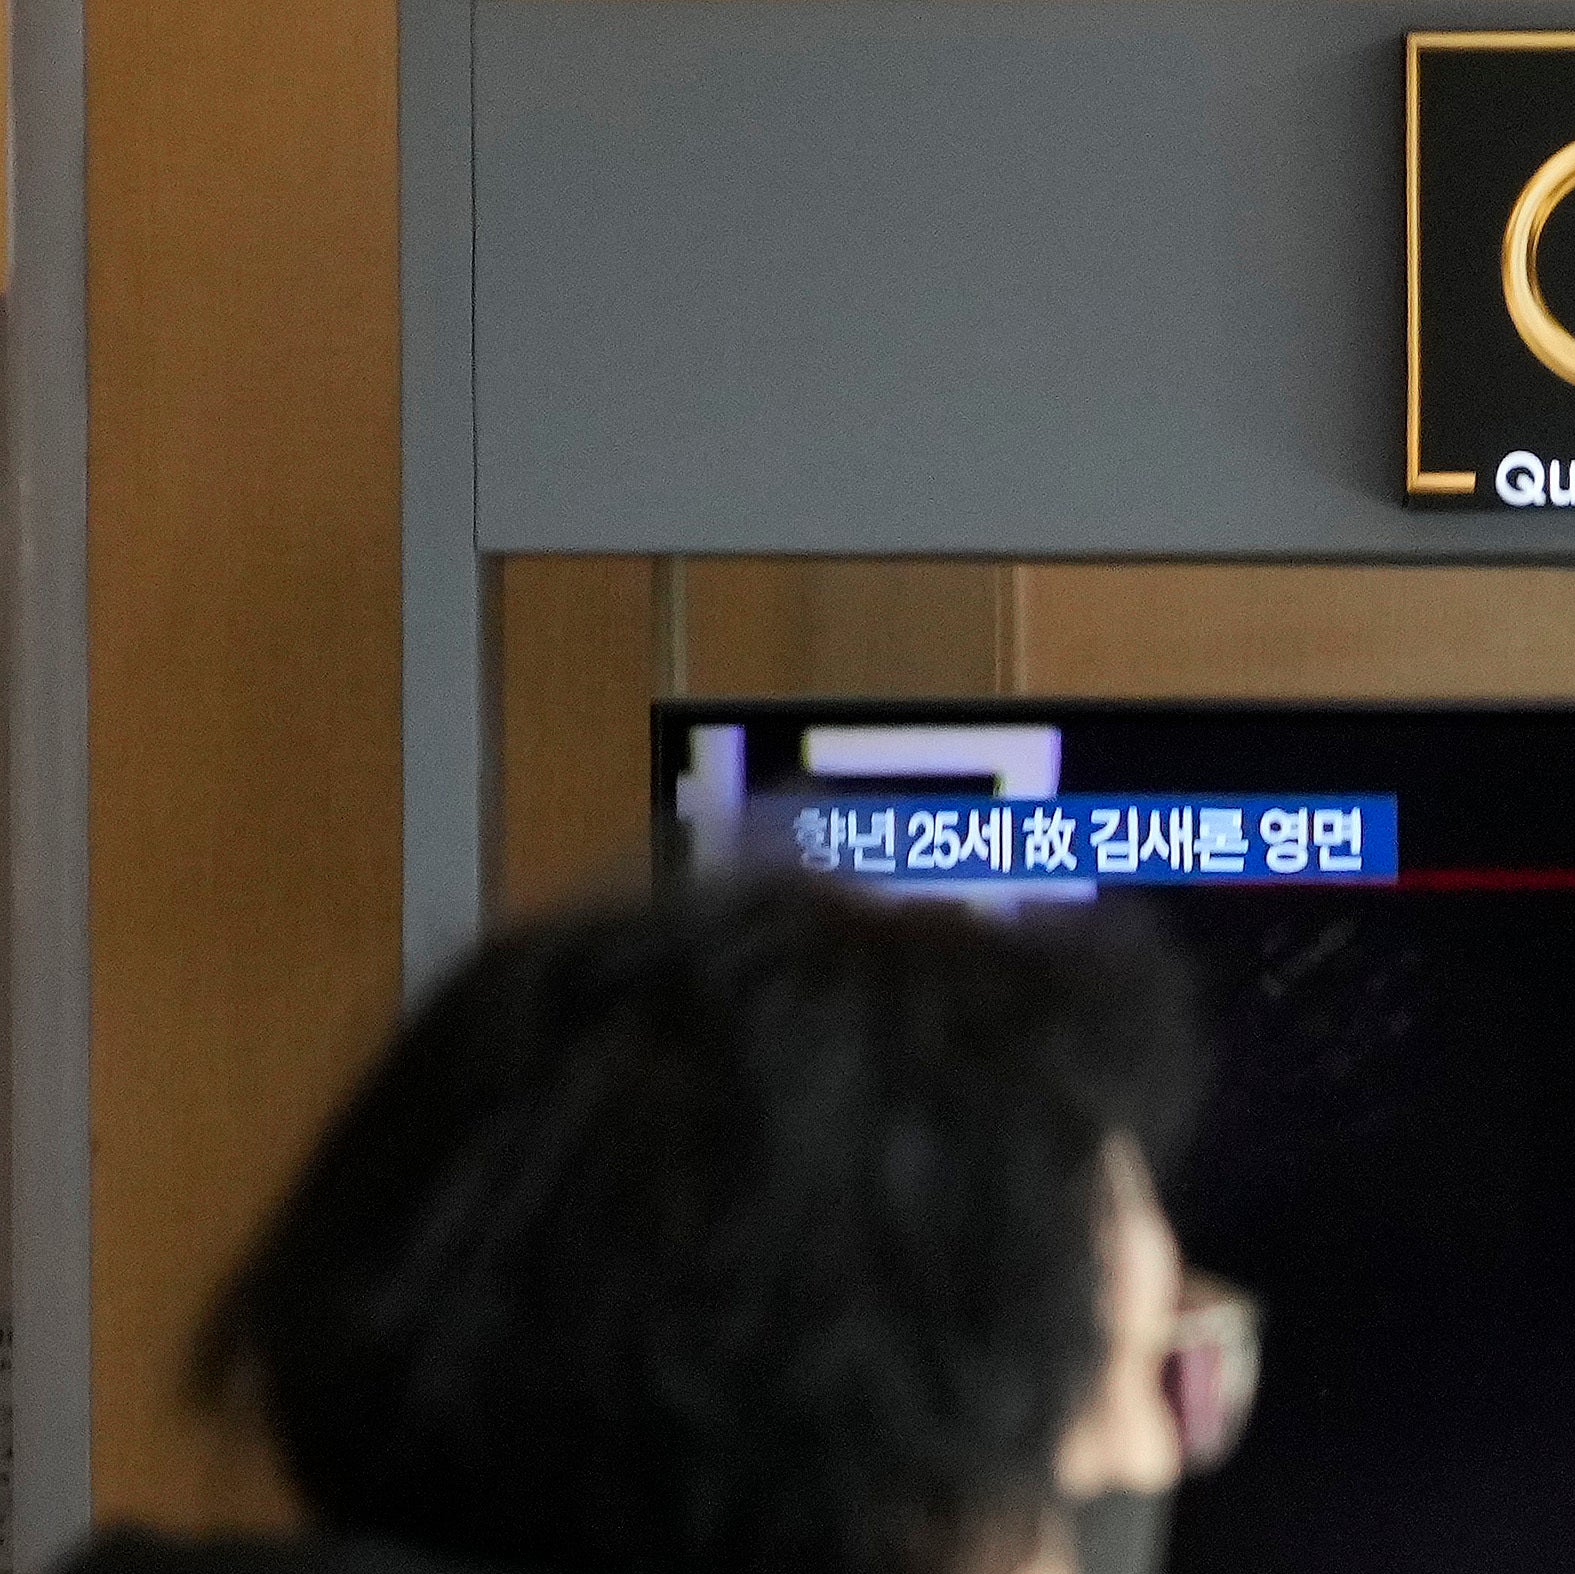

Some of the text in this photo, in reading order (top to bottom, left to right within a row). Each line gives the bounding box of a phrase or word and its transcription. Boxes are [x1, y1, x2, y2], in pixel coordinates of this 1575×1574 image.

[906, 806, 1013, 873] 25세
[1022, 806, 1078, 873] 故
[1089, 805, 1249, 873] 김새론
[1259, 806, 1363, 874] 영면
